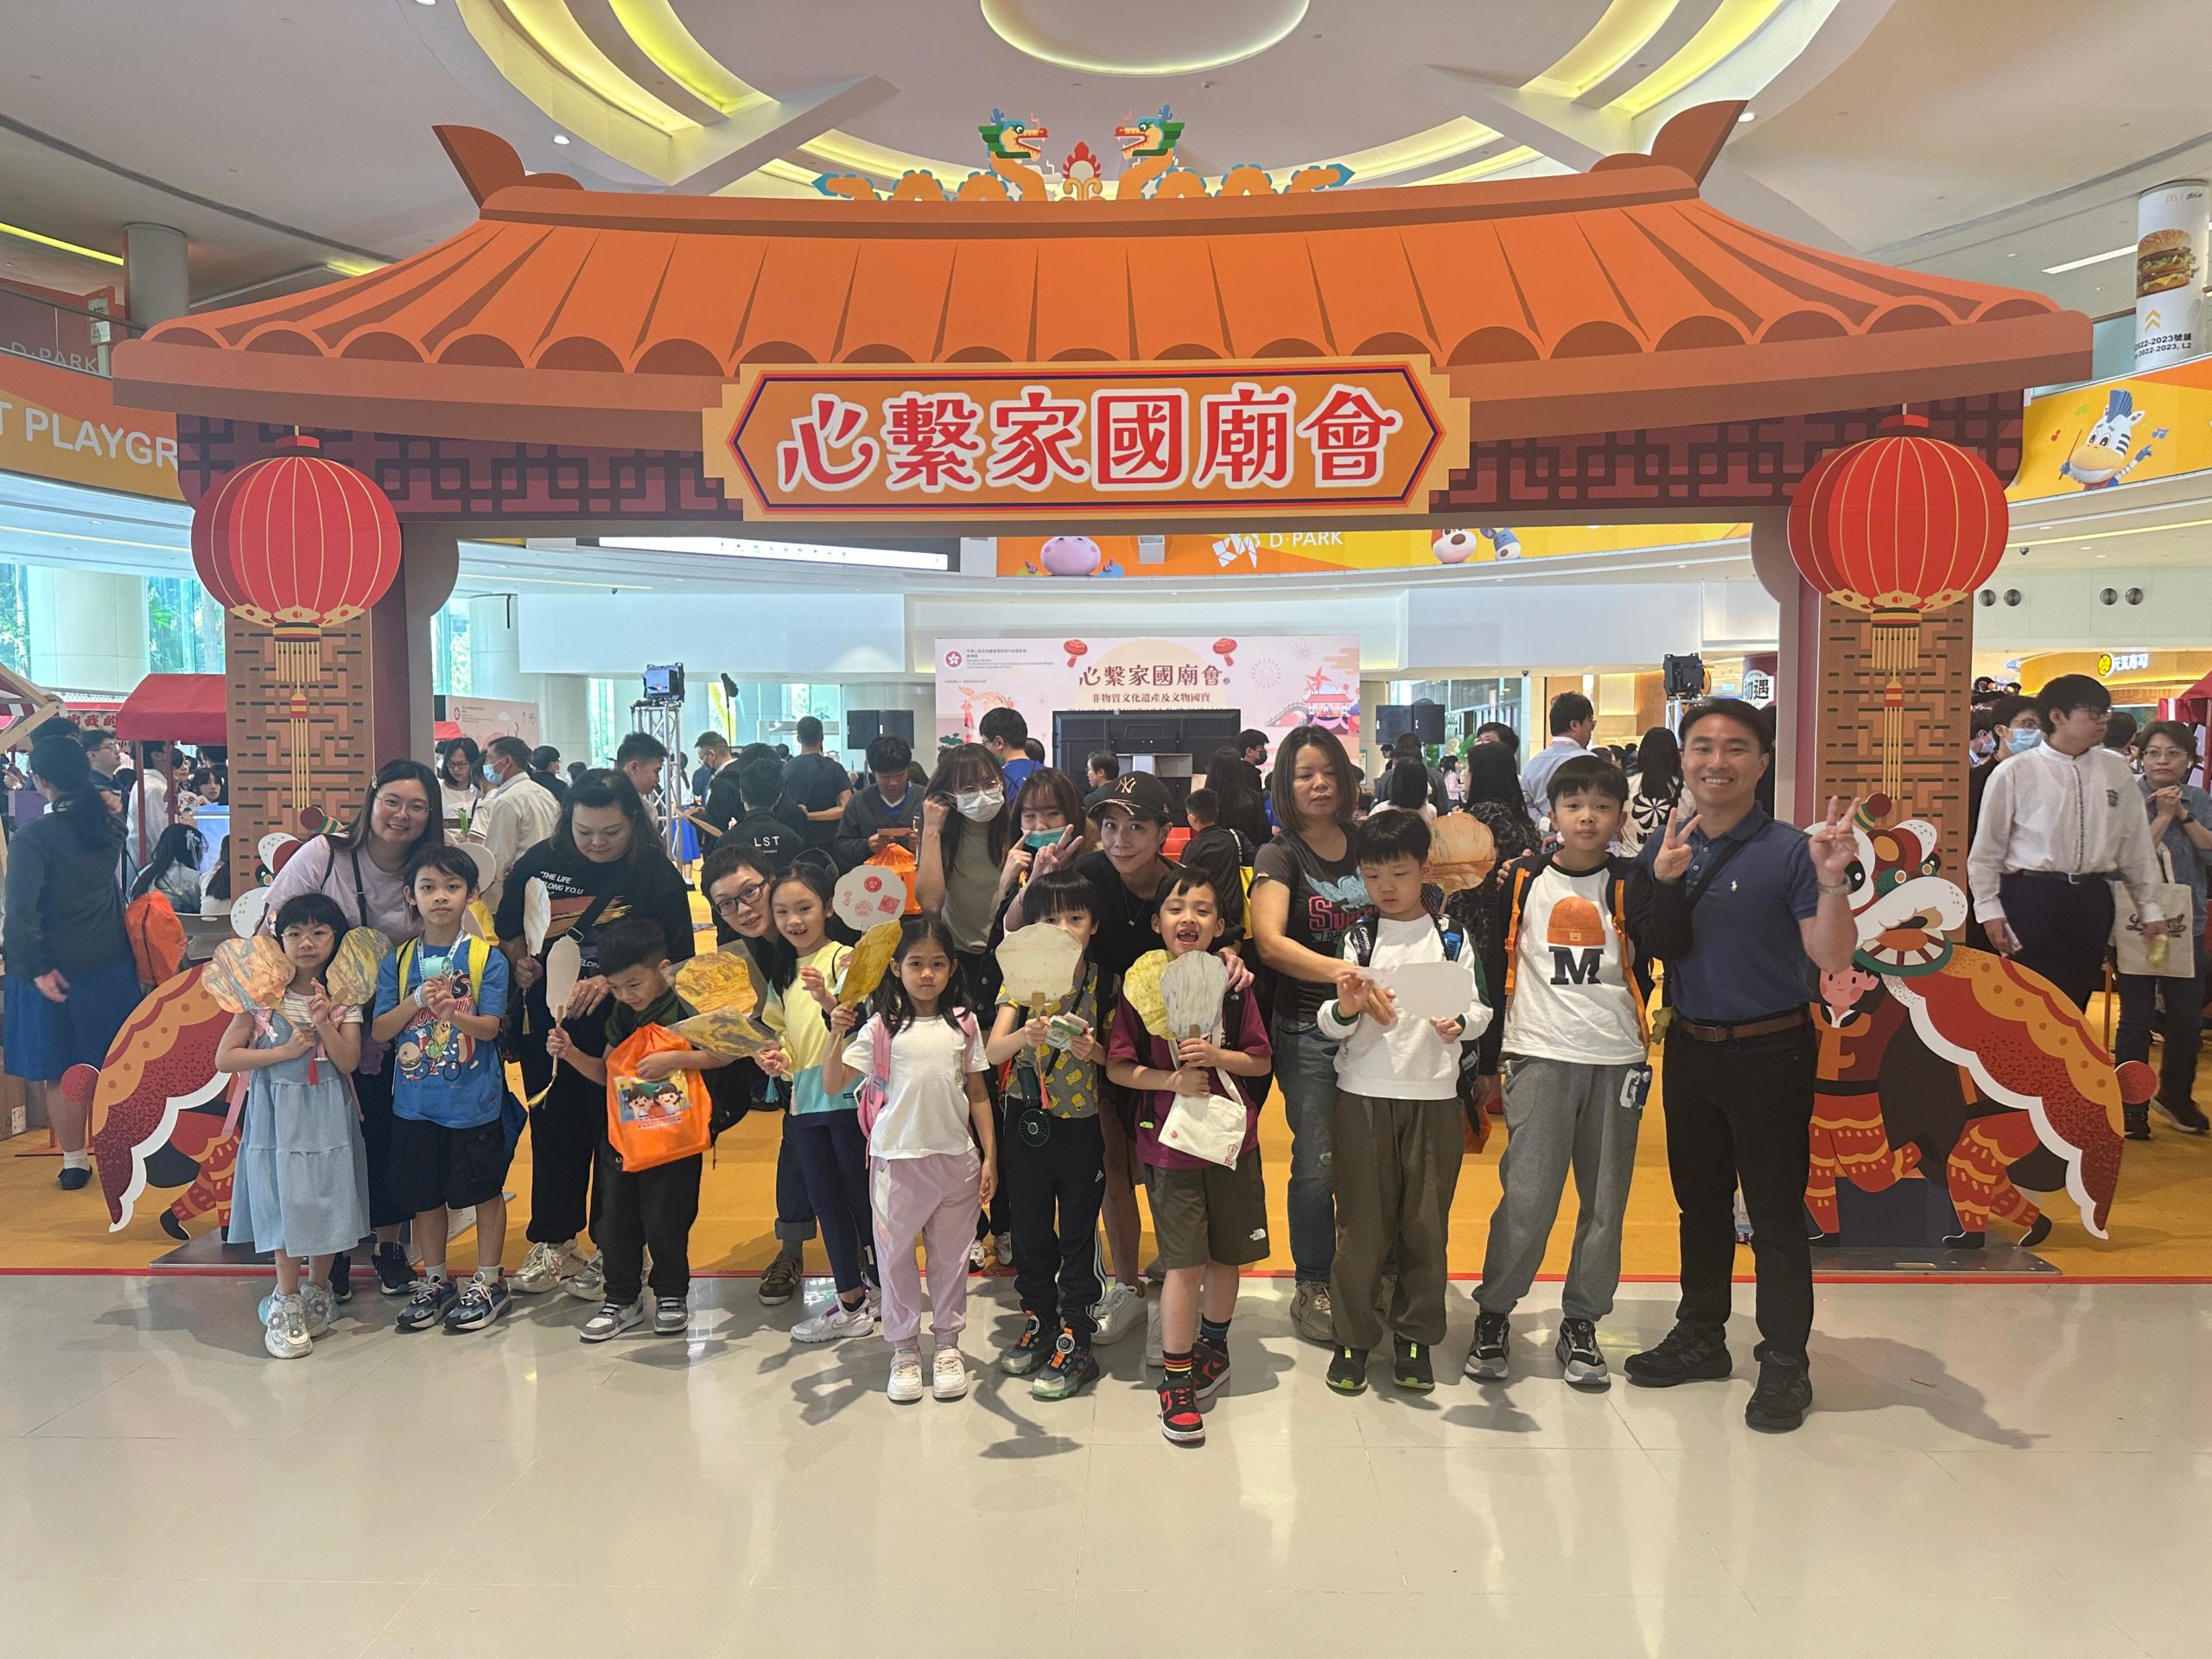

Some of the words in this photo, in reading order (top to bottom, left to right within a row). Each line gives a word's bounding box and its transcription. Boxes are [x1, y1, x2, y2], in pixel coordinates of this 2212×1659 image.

[779, 385, 1400, 492] 心繫家國廟會
[1079, 664, 1223, 686] 心繫家國廟會
[753, 836, 779, 847] LST
[556, 874, 572, 884] LIFE
[1548, 945, 1605, 985] M
